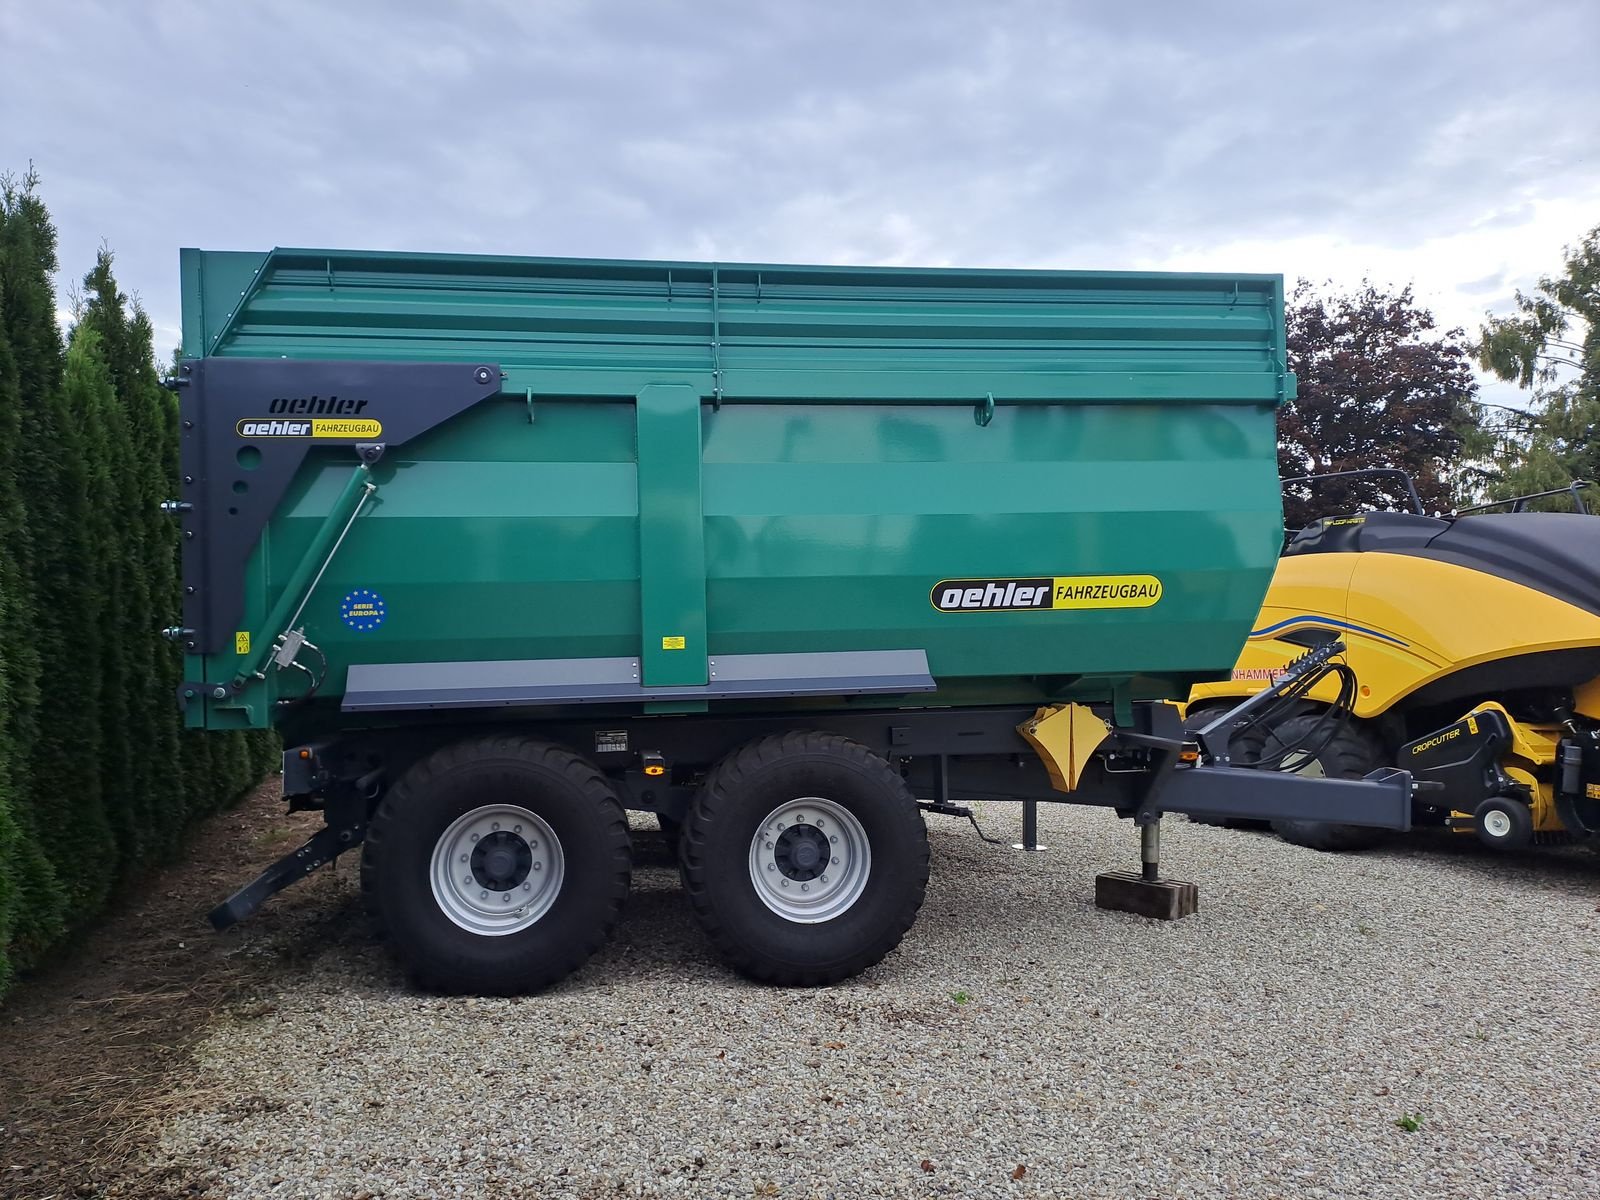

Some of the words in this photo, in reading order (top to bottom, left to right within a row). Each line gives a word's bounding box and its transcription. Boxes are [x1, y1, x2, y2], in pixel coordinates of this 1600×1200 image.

[269, 395, 368, 414] oehler
[242, 421, 310, 435] oehler
[315, 423, 379, 433] FAHRZEUGBAU
[940, 582, 1050, 608] oehler
[1056, 584, 1160, 600] FAHRZEUGBAU
[1412, 728, 1460, 754] CROPCUTTER
